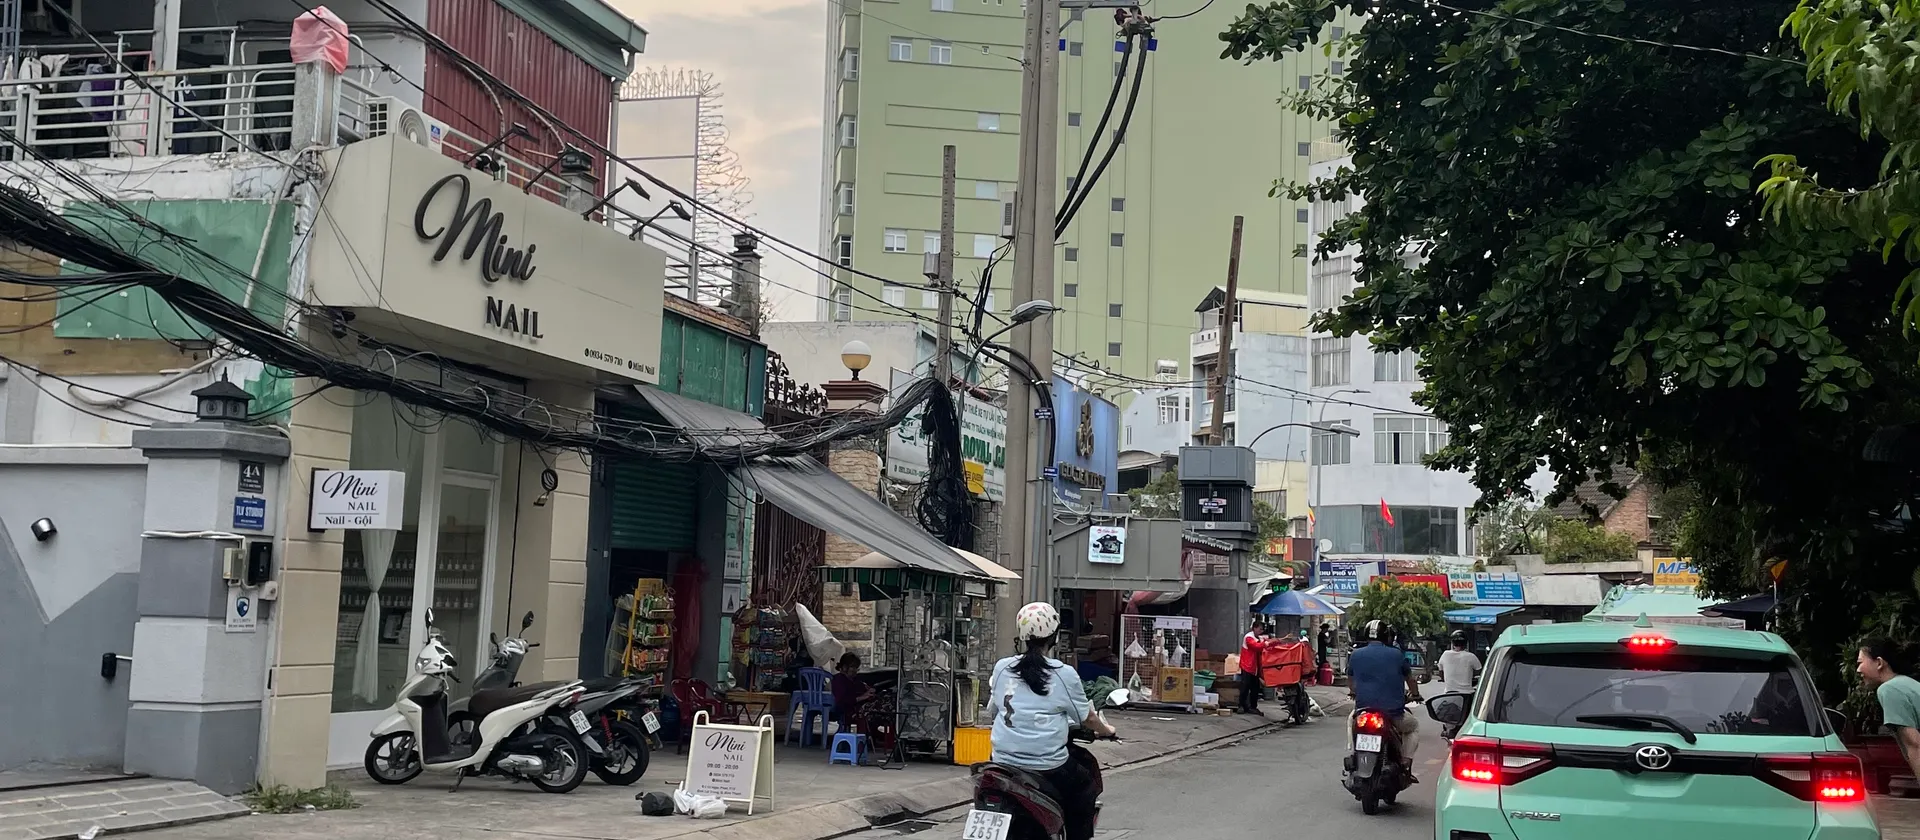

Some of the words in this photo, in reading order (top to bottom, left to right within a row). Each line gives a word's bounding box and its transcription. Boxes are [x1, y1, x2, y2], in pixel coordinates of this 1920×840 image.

[415, 174, 537, 282] Mini
[486, 296, 543, 338] NAIL
[243, 465, 260, 478] 4A
[322, 471, 378, 499] Mini
[348, 501, 377, 511] NAIL
[325, 515, 345, 525] Nail
[354, 515, 372, 527] Gội
[1451, 580, 1474, 589] SÁNG
[705, 731, 746, 753] Mini
[723, 753, 744, 762] NAIL
[1511, 811, 1561, 822] RAIZE
[969, 825, 1001, 840] 2651
